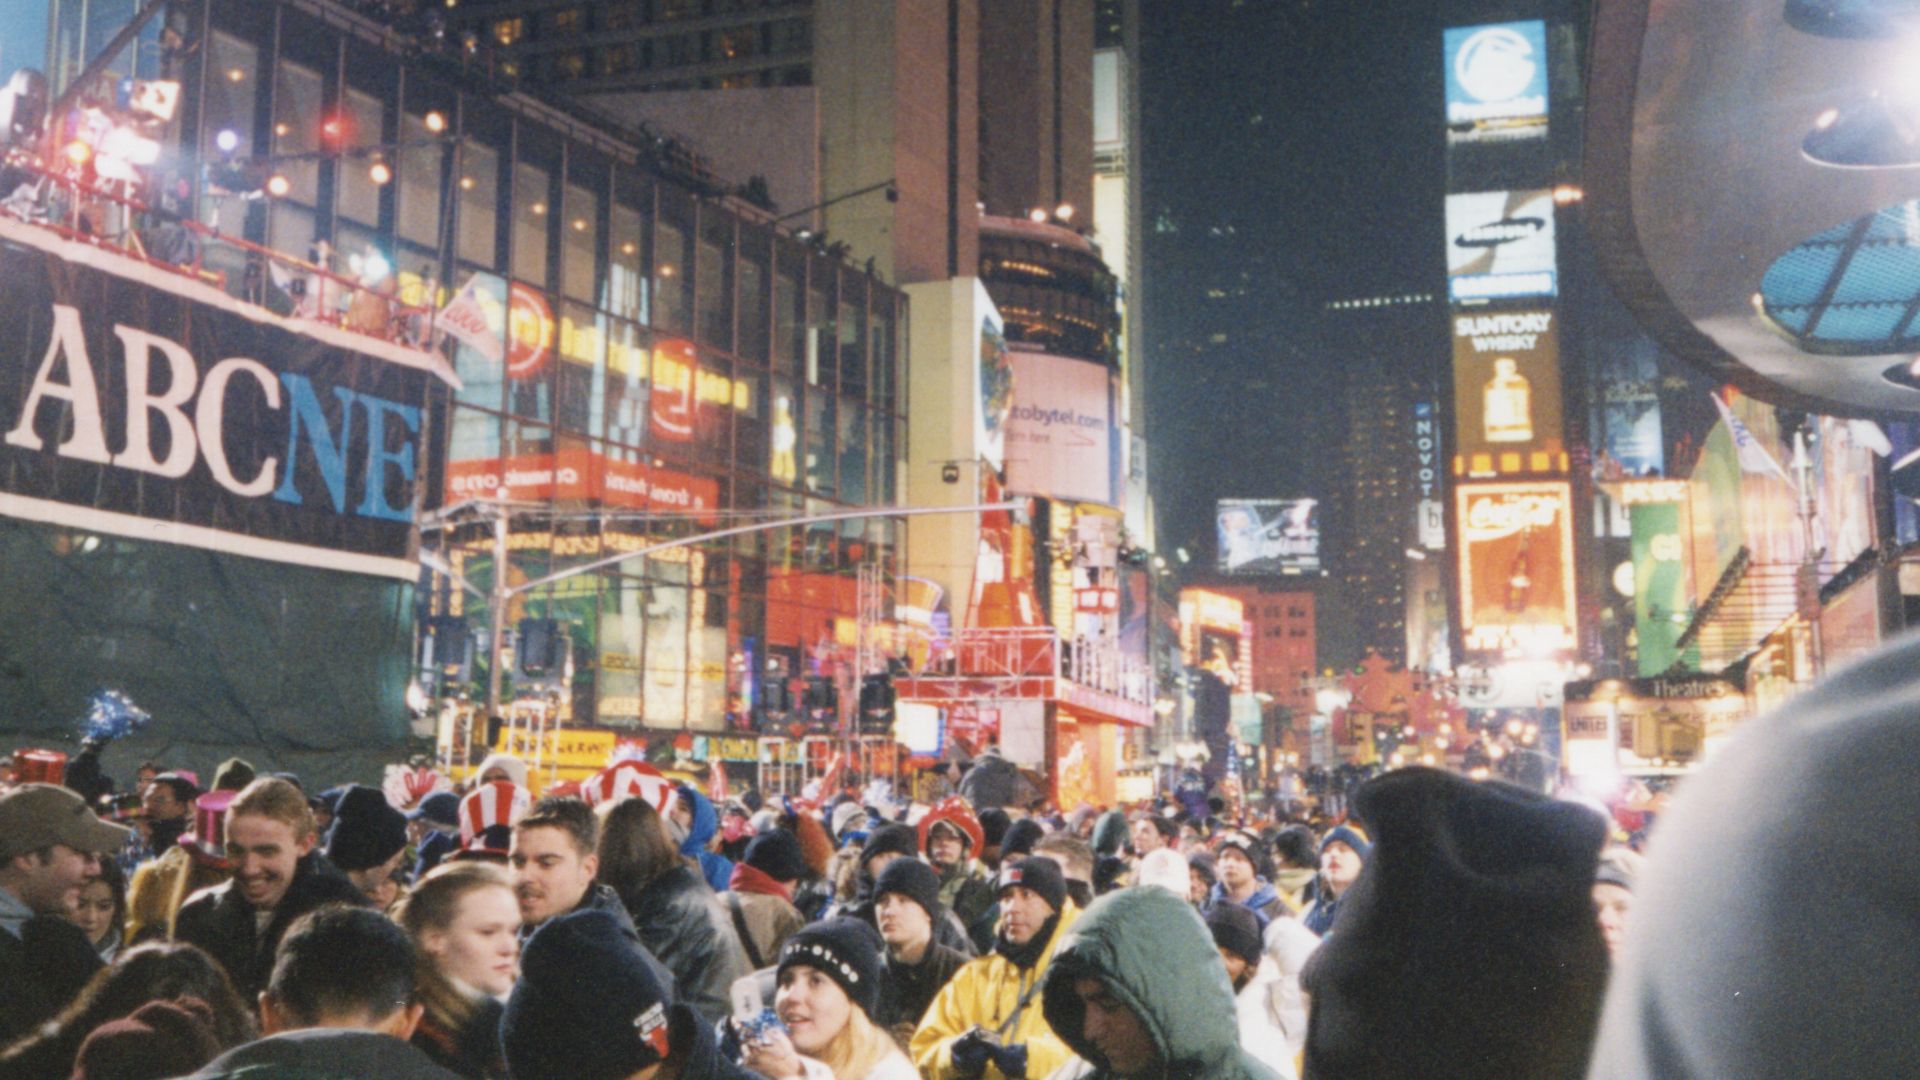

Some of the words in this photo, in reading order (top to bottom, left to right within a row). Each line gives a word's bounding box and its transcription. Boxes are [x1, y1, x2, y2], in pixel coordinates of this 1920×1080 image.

[1455, 312, 1552, 337] SUNTORY
[1471, 334, 1538, 352] WHISKY
[1654, 680, 1725, 697] Theatres
